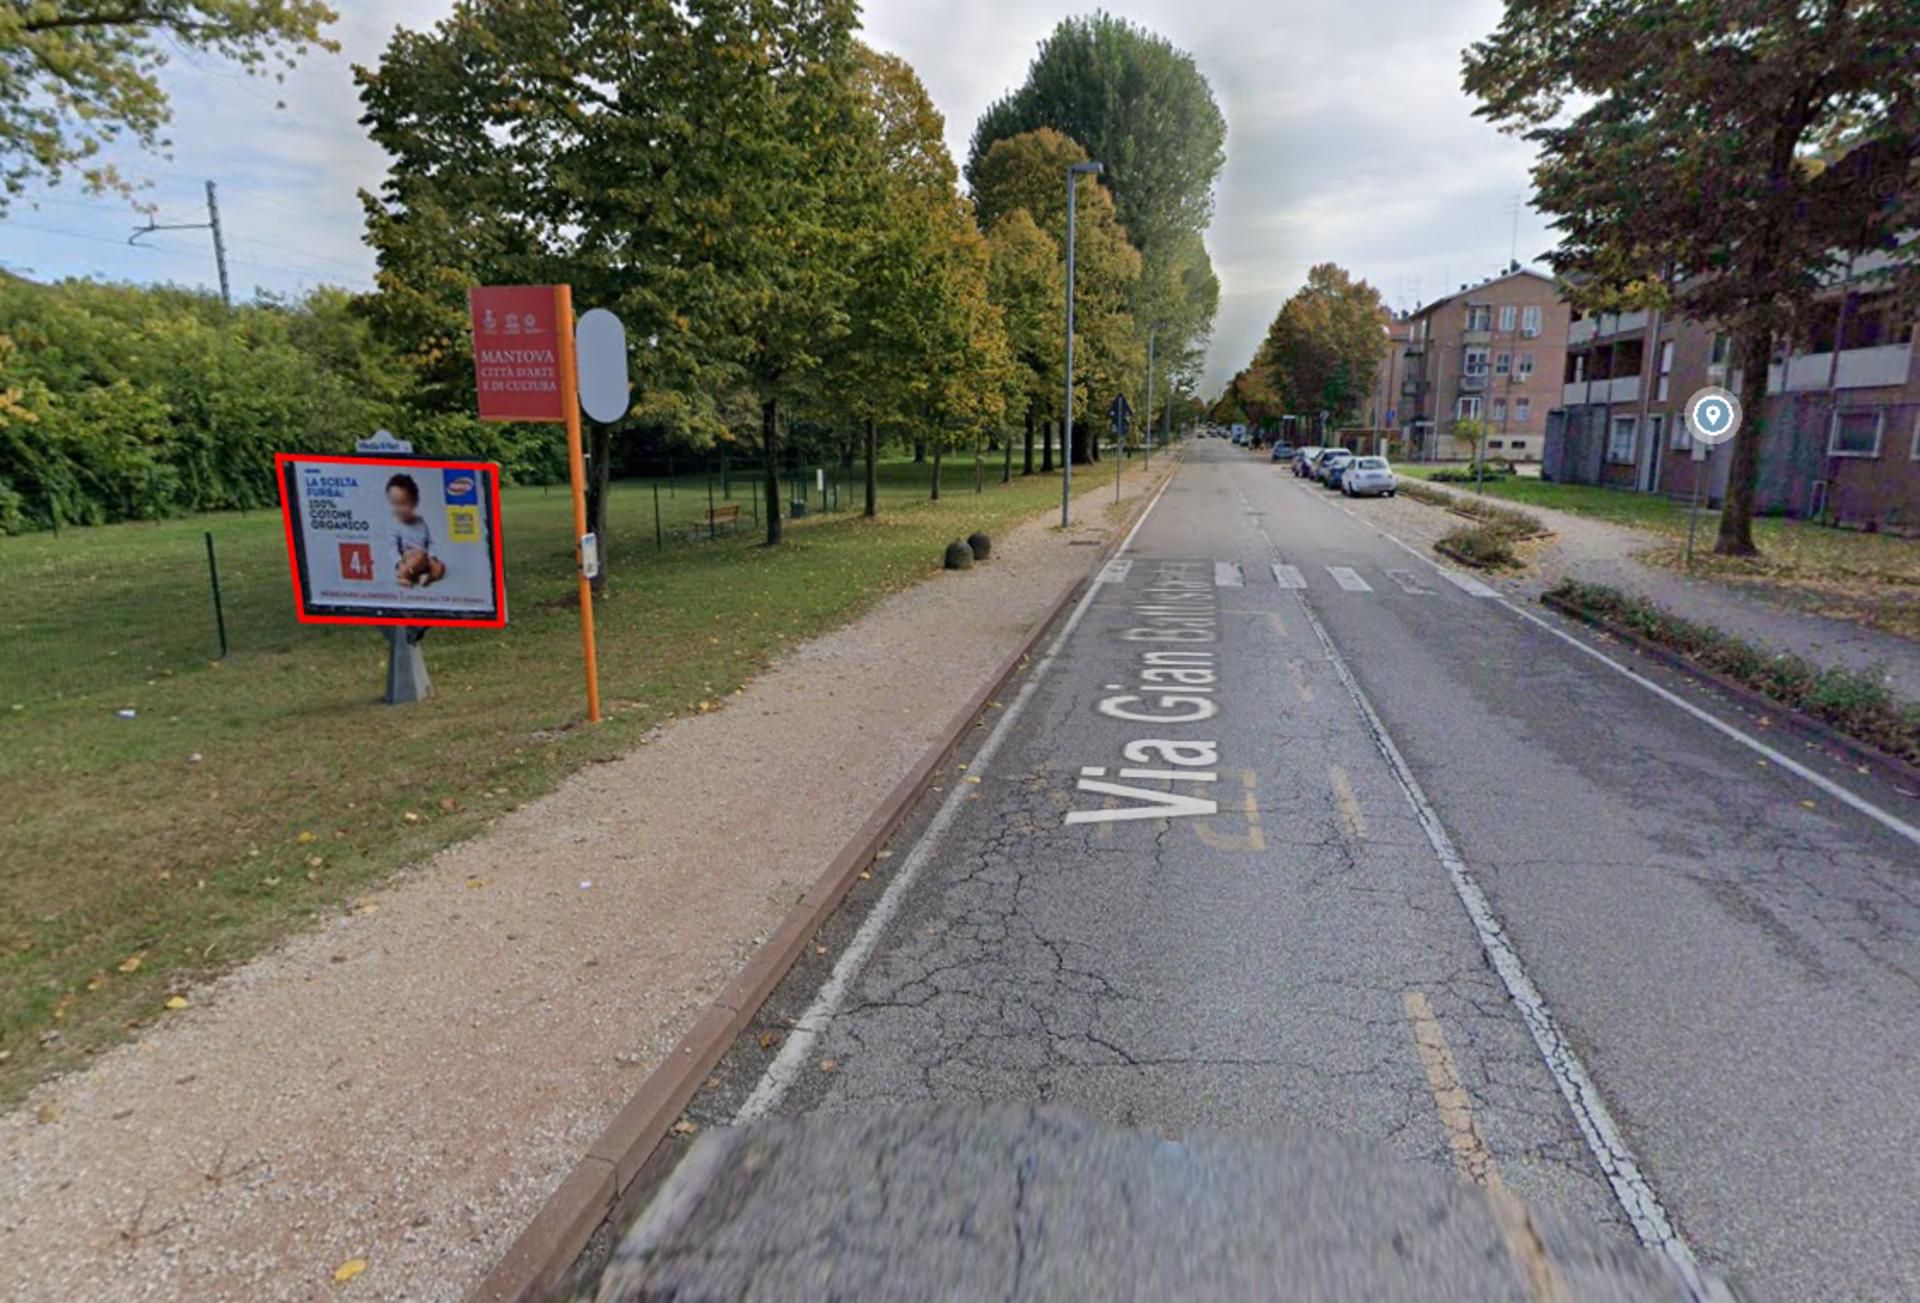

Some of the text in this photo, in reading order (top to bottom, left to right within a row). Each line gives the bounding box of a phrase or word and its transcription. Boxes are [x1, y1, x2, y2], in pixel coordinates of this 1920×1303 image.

[481, 350, 555, 364] MANTOVA
[491, 381, 505, 391] DI
[305, 476, 359, 488] LA SCELTA
[309, 509, 353, 520] COTONE
[311, 519, 370, 531] ORGANICO
